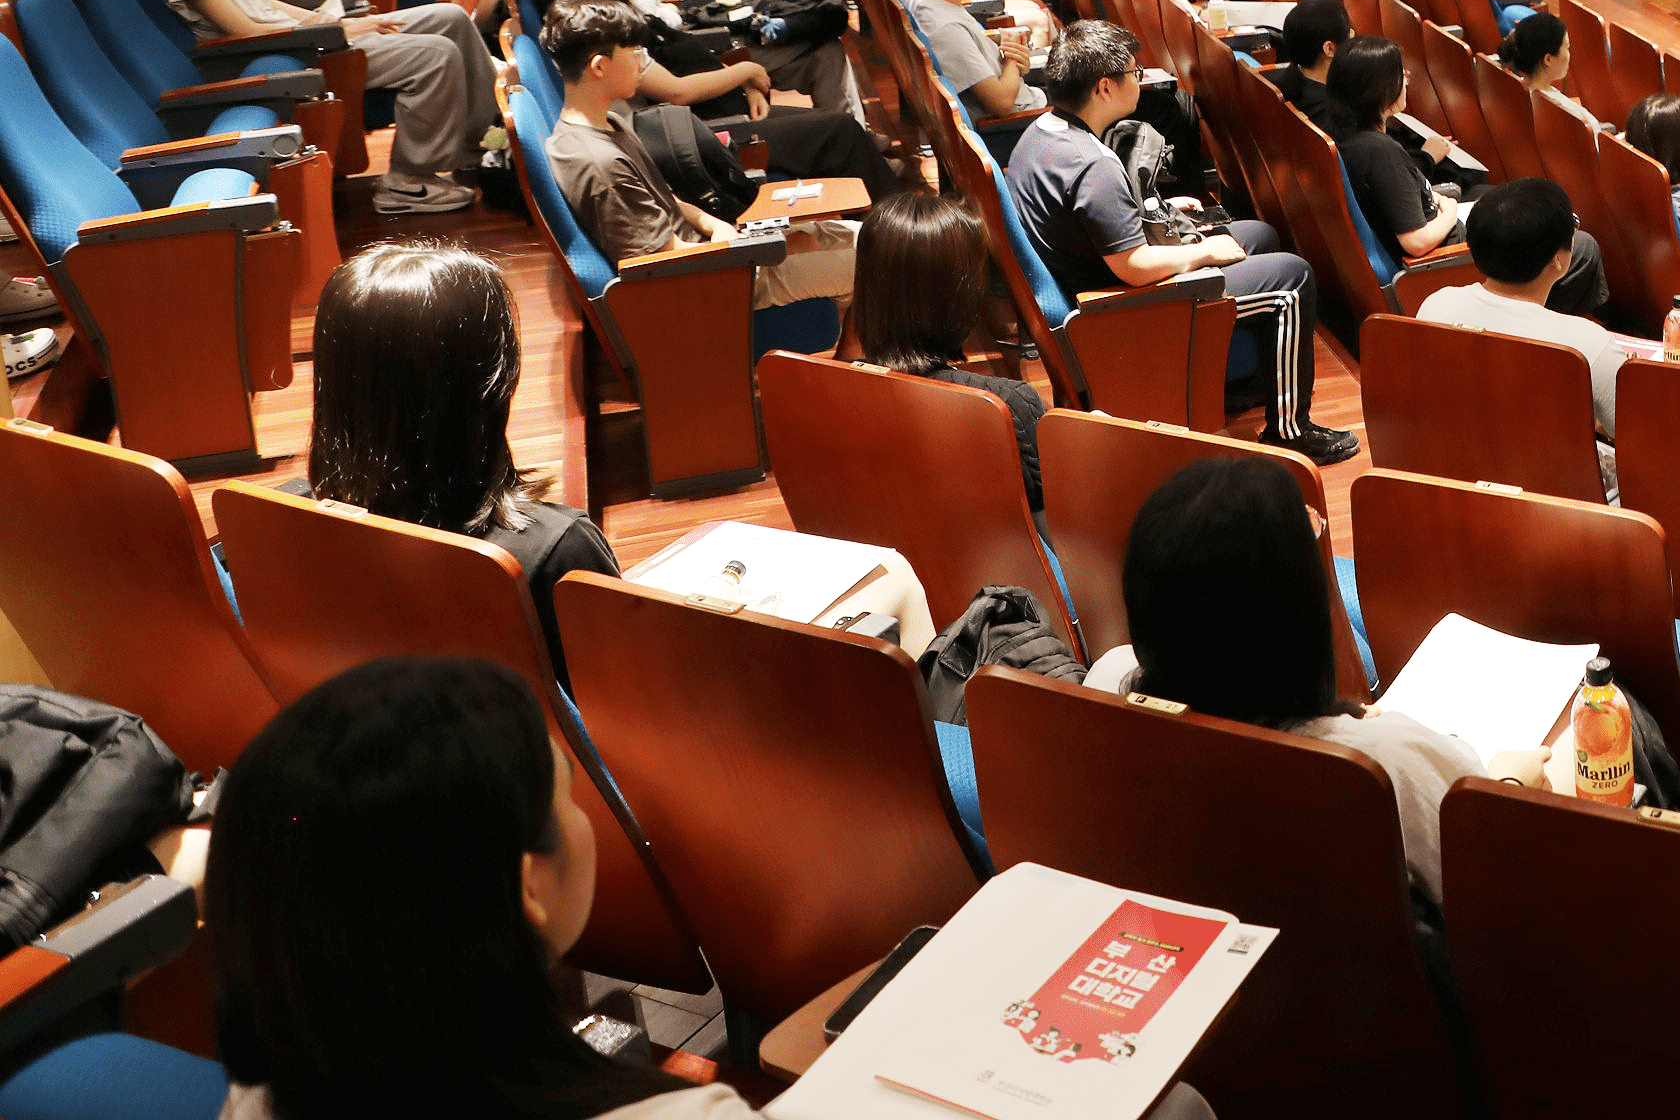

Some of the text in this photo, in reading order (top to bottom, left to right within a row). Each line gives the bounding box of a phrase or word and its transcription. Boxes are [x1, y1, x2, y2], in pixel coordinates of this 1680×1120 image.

[1577, 762, 1630, 781] Marllin
[1592, 780, 1618, 789] ZERO
[1103, 940, 1176, 973] 부 산
[1085, 957, 1160, 992] 디지털
[1068, 975, 1144, 1009] 대학교
